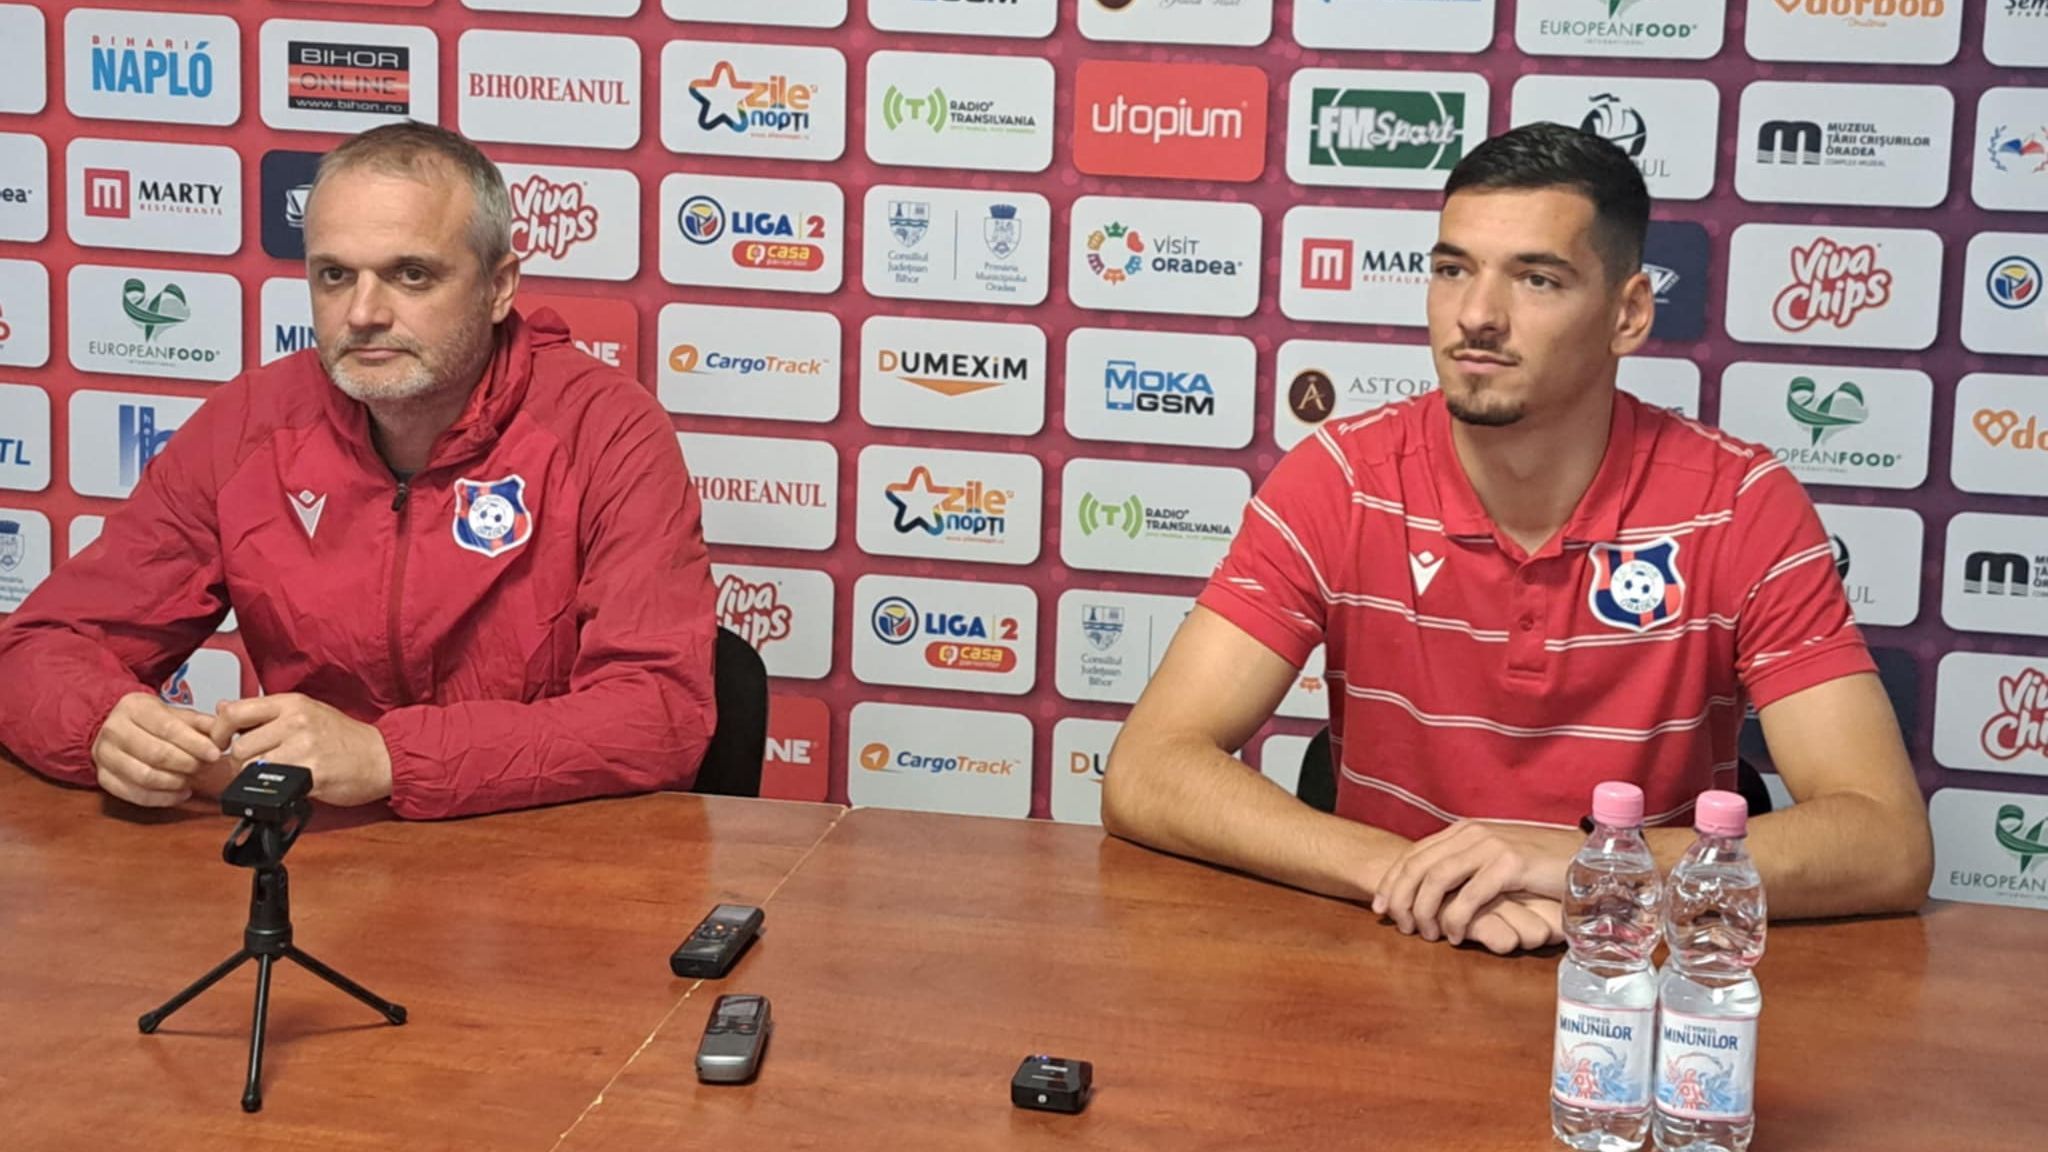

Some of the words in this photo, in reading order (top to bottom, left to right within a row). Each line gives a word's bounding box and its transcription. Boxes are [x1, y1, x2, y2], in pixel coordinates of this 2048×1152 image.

[92, 35, 188, 50] BIHARI
[92, 41, 212, 97] NAPLÓ
[301, 48, 399, 68] BIHOR
[300, 72, 397, 95] ONLINE
[469, 73, 629, 106] BIHOREANUL
[744, 75, 811, 110] zile
[950, 100, 989, 112] RADIO
[951, 112, 1036, 127] TRANSILVANIA
[1092, 95, 1242, 144] utopium
[1827, 122, 1877, 133] MUZEUL
[1825, 147, 1876, 156] ORADEA
[138, 179, 223, 205] MARTY
[511, 174, 582, 220] Viva
[140, 203, 223, 215] RESTAURANTS
[511, 205, 598, 261] Chips
[732, 211, 793, 236] LIGA
[806, 215, 825, 238] 2
[767, 245, 810, 260] casa
[1362, 250, 1433, 273] MAR
[1791, 236, 1875, 286] Viva
[1772, 268, 1893, 333] Chips
[706, 351, 821, 376] CargoTrack
[1105, 368, 1214, 395] MOKA
[1349, 377, 1433, 396] ASTOR
[1136, 393, 1214, 416] GSM
[1775, 448, 1896, 467] OPEANFOOD
[694, 476, 827, 507] HOREANUL
[941, 480, 1007, 514] zile
[1145, 508, 1187, 520] RADIO
[1146, 519, 1232, 535] TRANSILVANIA
[925, 612, 987, 638] LIGA
[1000, 618, 1018, 640] 2
[960, 646, 1003, 662] casa
[896, 750, 1013, 776] CargoTrack
[1950, 870, 2047, 892] EUROPEAN
[1560, 1015, 1632, 1041] MINUNILOR
[1664, 1026, 1738, 1050] MINUNILOR
